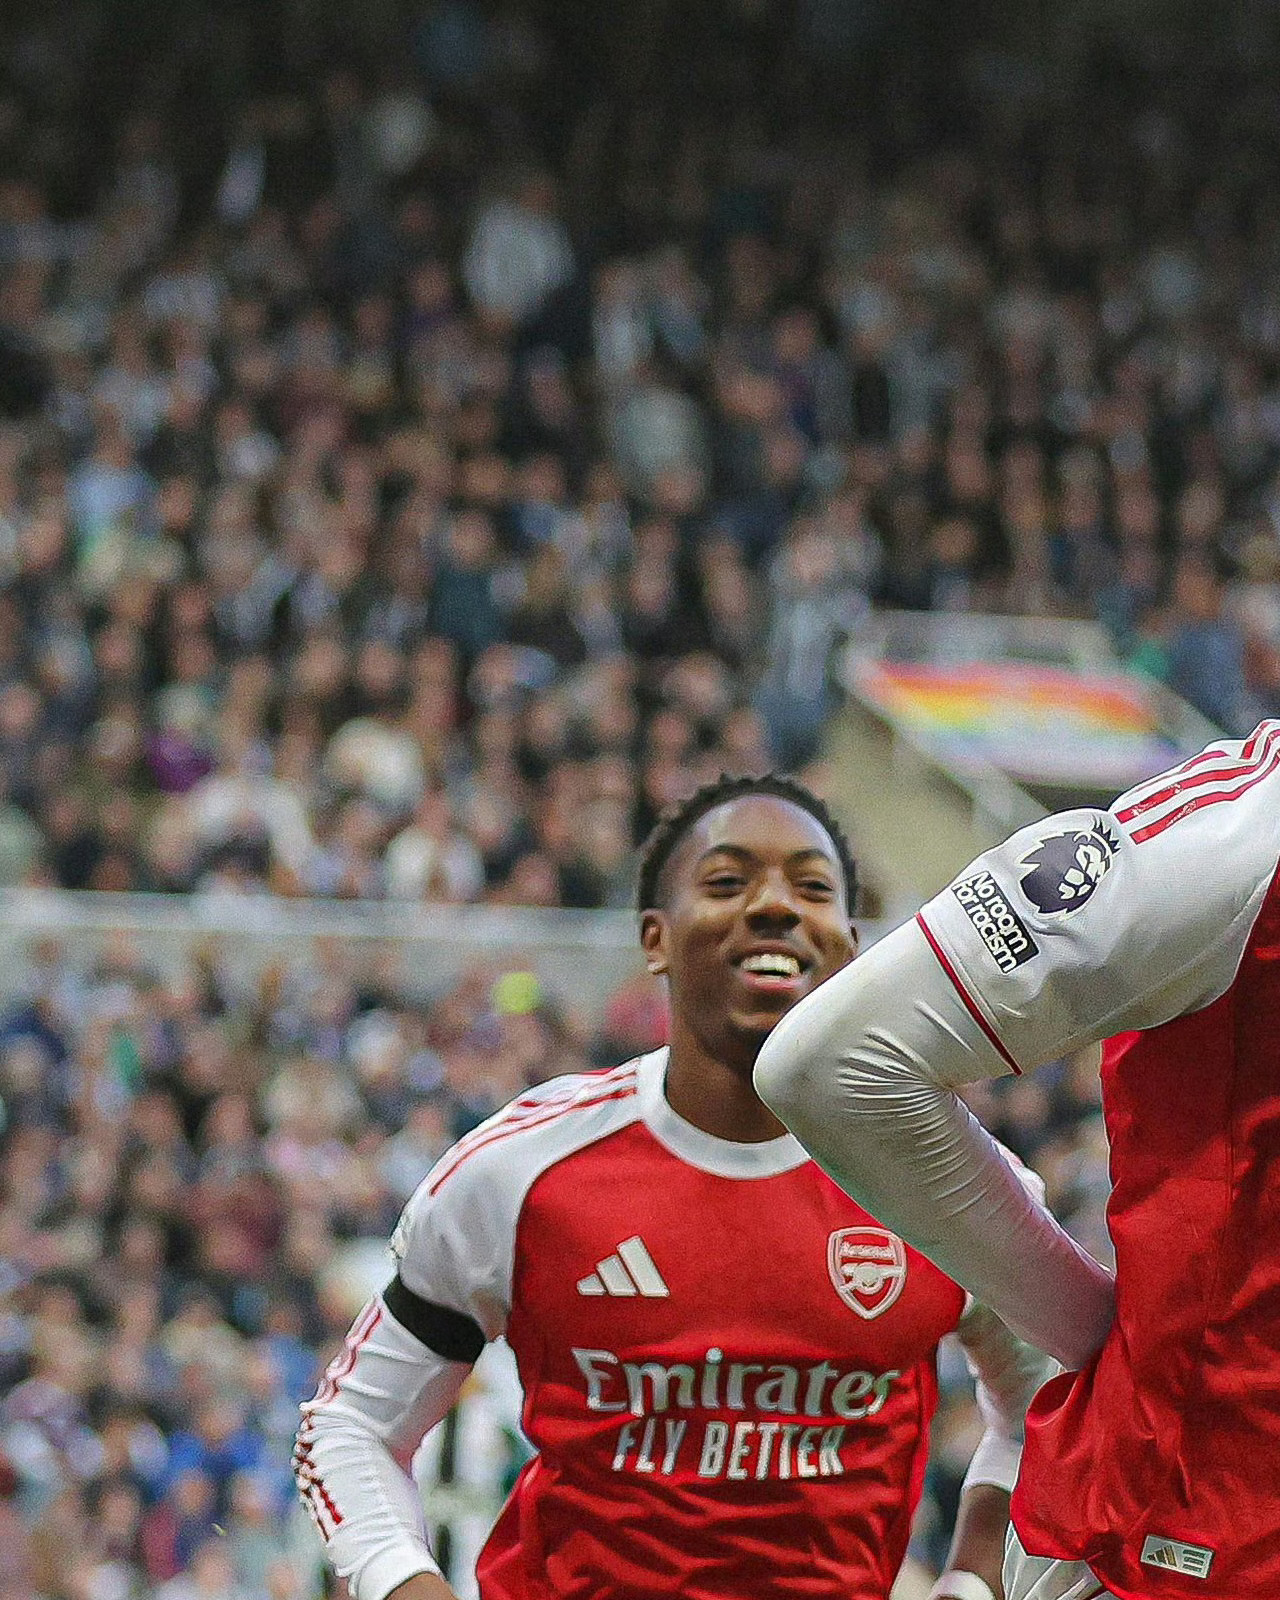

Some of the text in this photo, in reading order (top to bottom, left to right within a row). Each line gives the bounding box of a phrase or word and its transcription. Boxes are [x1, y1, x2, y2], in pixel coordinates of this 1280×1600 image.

[951, 880, 1018, 973] for racism
[972, 870, 1029, 955] No room
[571, 1347, 901, 1420] Emirates
[611, 1417, 846, 1481] FLY BETTER
